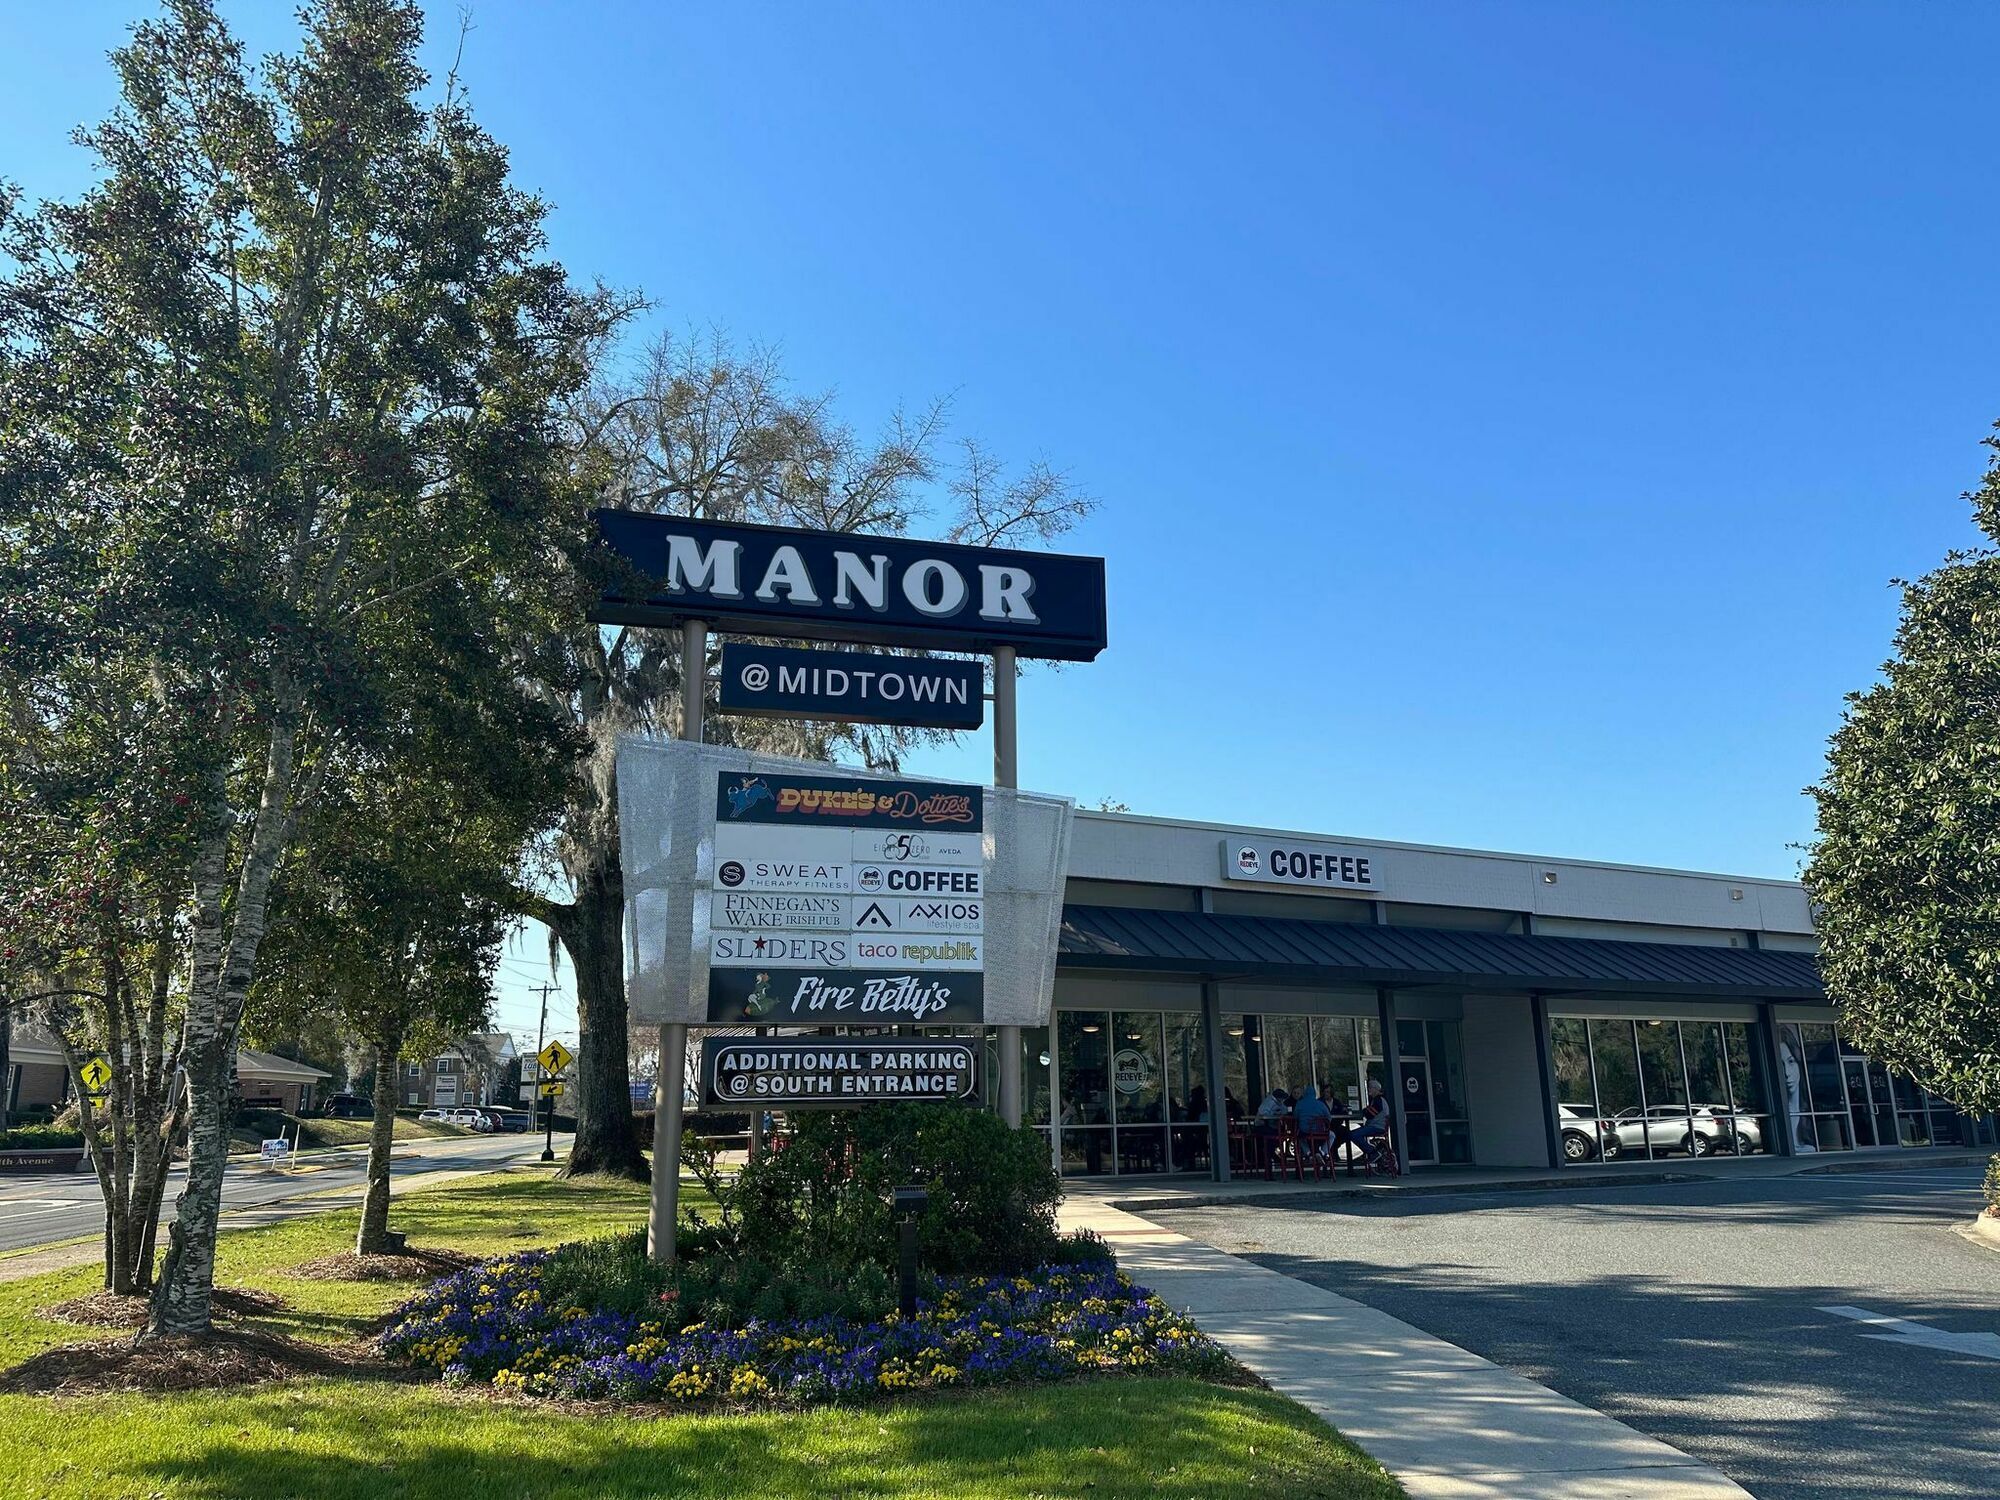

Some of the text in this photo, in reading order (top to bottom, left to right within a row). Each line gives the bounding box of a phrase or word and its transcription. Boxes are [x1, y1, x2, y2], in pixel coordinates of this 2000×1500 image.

[666, 535, 1041, 625] MANOR
[776, 787, 974, 824] DUKE'S & Dottie's
[756, 863, 843, 879] SWEAT
[1239, 849, 1372, 884] REDEYE COFFEE
[750, 879, 849, 889] THERAPY FITNESS
[887, 869, 979, 893] COFFEE
[725, 894, 840, 913] FINNEGAN'S
[908, 903, 980, 920] AXIOS
[725, 910, 841, 927] WAKE IRISH PUB
[926, 920, 980, 930] lifestyle spa
[715, 935, 846, 967] SLIDERS
[858, 941, 978, 963] taco republik
[790, 975, 951, 1020] Fire Betty's
[722, 1052, 967, 1071] ADDITIONAL PARKING
[730, 1074, 958, 1094] @ SOUTH ENTRANCE
